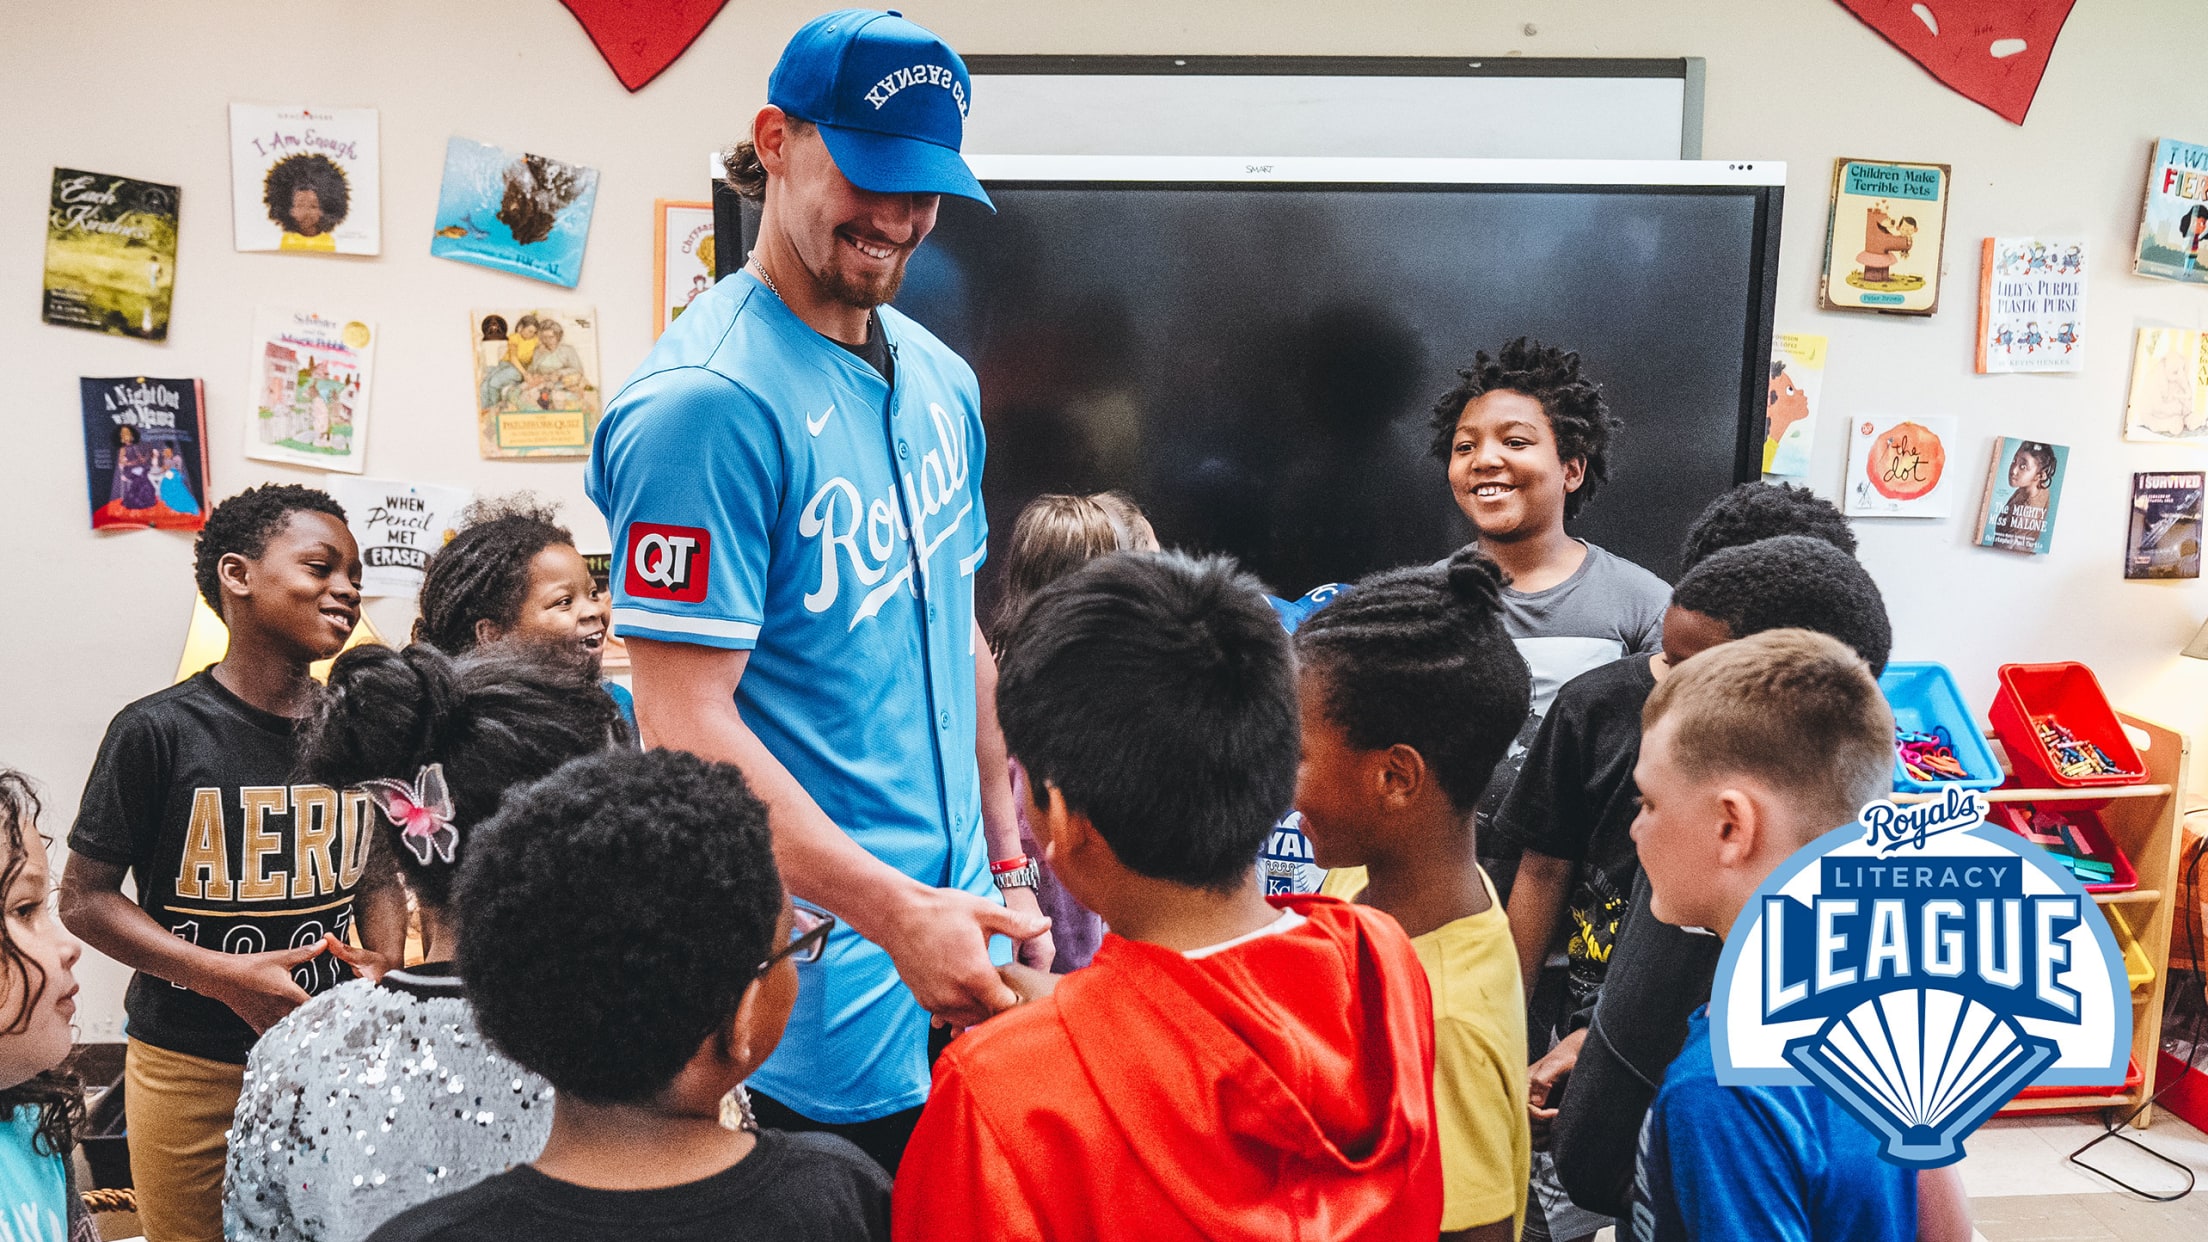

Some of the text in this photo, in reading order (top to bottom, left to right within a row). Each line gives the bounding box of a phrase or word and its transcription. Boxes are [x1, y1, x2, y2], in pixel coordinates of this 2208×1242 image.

[252, 129, 357, 160] I Am Enough
[2169, 147, 2179, 165] I
[1246, 165, 1273, 173] SMART
[1851, 166, 1935, 183] Children Make
[61, 175, 125, 205] Each
[1854, 178, 1930, 196] Terrible Pets
[1998, 280, 2079, 296] LILLY'S PURPLE
[1999, 298, 2078, 313] PLASTIC PURSE
[104, 383, 179, 410] A Night Out
[1892, 435, 1920, 456] the
[1883, 456, 1928, 482] dot
[2146, 475, 2200, 489] SURVIVED
[386, 496, 425, 512] WHEN
[2012, 504, 2047, 519] MIGHTY
[365, 507, 434, 531] Pencil
[2010, 517, 2048, 532] MALONE
[387, 530, 416, 544] MET
[371, 548, 426, 566] ERASER
[635, 533, 697, 588] QT
